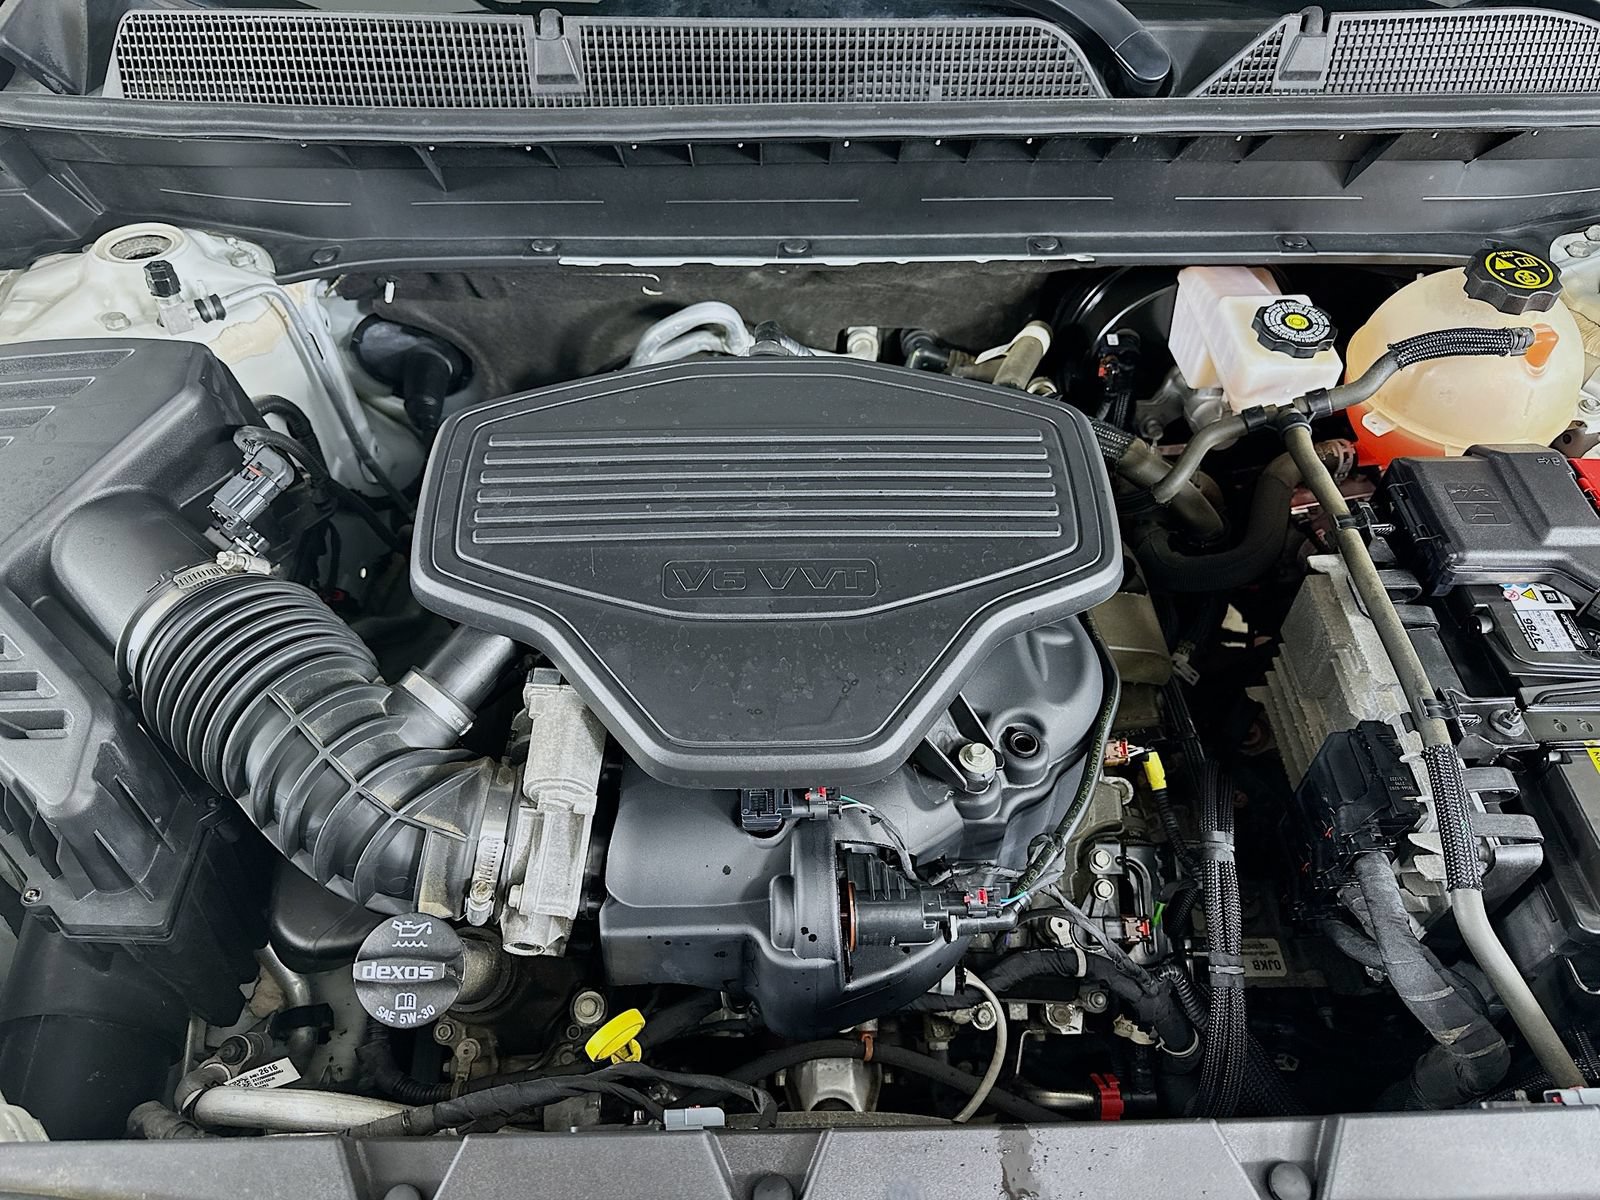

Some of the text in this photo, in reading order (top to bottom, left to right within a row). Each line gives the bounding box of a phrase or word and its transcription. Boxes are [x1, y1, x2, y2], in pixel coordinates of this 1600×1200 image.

[672, 567, 868, 591] V6 VVT
[1523, 618, 1545, 645] 3786
[362, 961, 435, 980] dexos
[376, 1004, 436, 1024] SAE 5W-30
[258, 1064, 279, 1076] 2616
